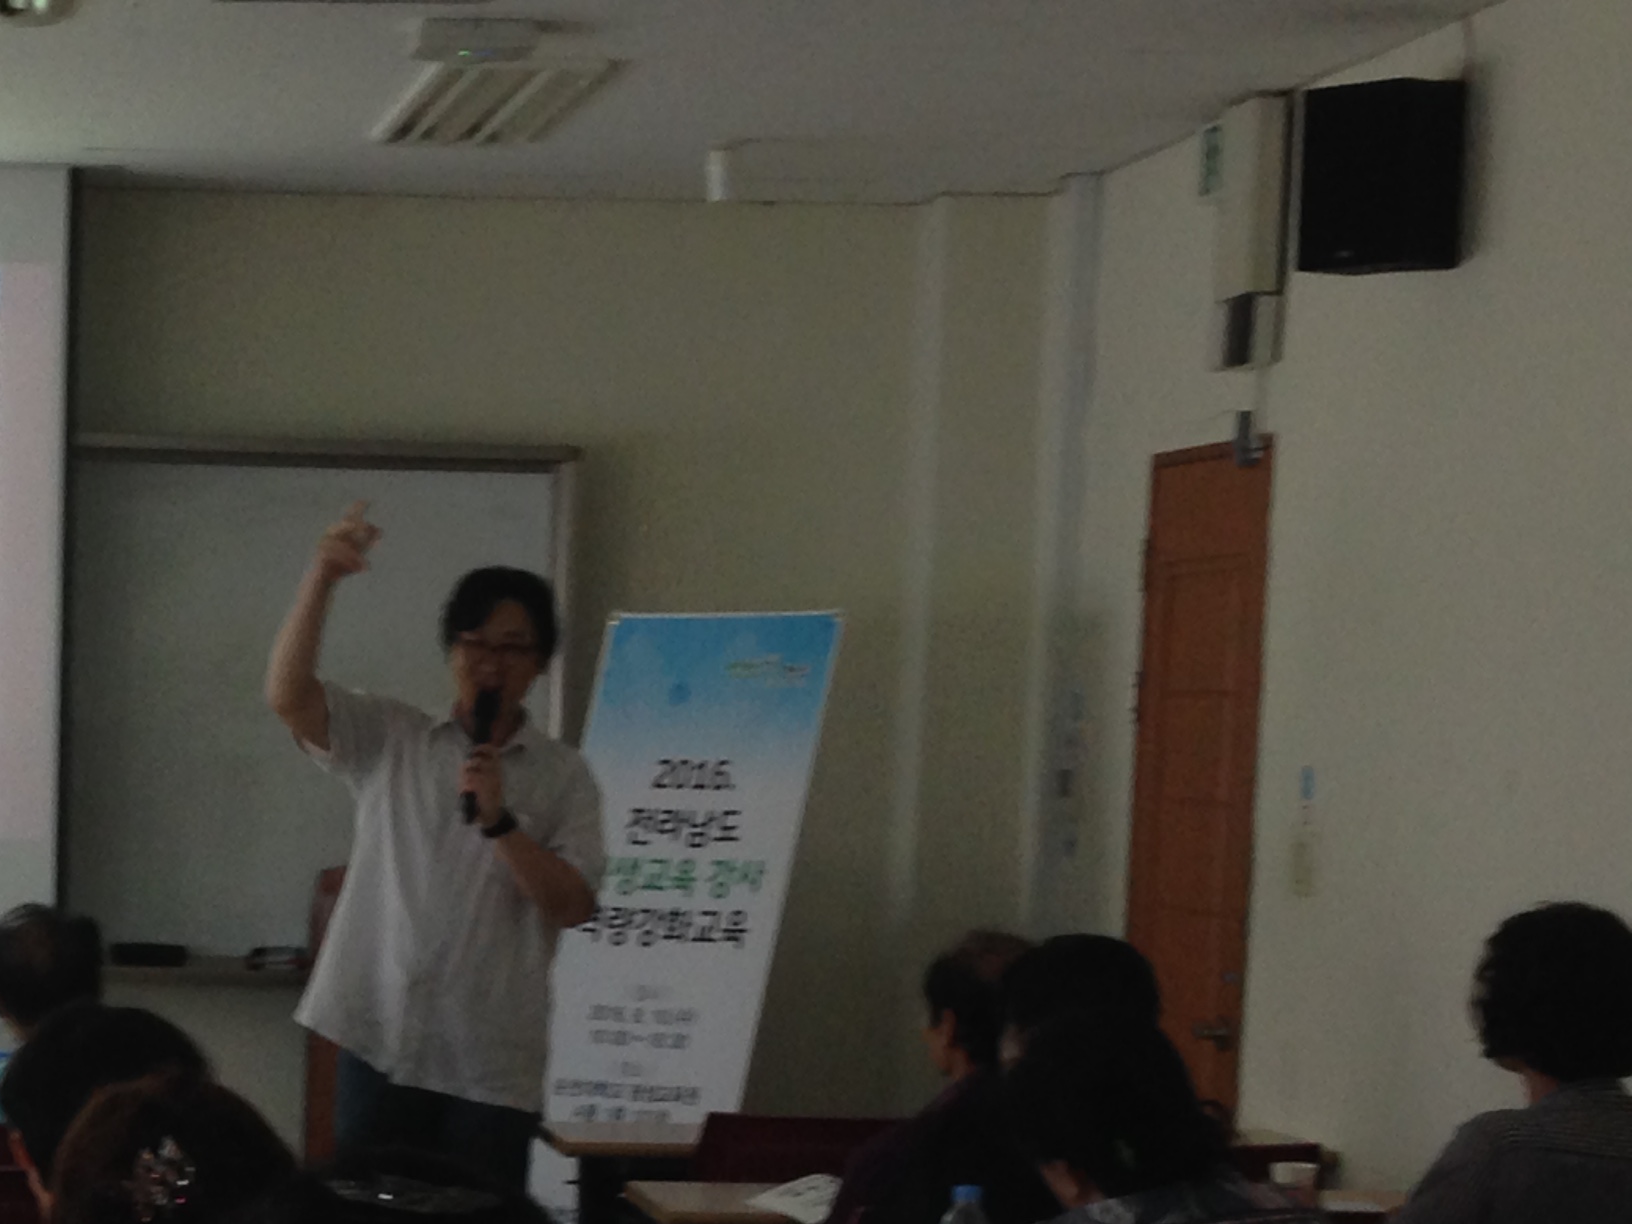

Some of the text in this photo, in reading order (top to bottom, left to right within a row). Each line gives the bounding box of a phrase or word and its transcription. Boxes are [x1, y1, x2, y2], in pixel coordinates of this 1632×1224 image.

[626, 808, 741, 849] 전라남도
[608, 857, 766, 899] 생교육 강사
